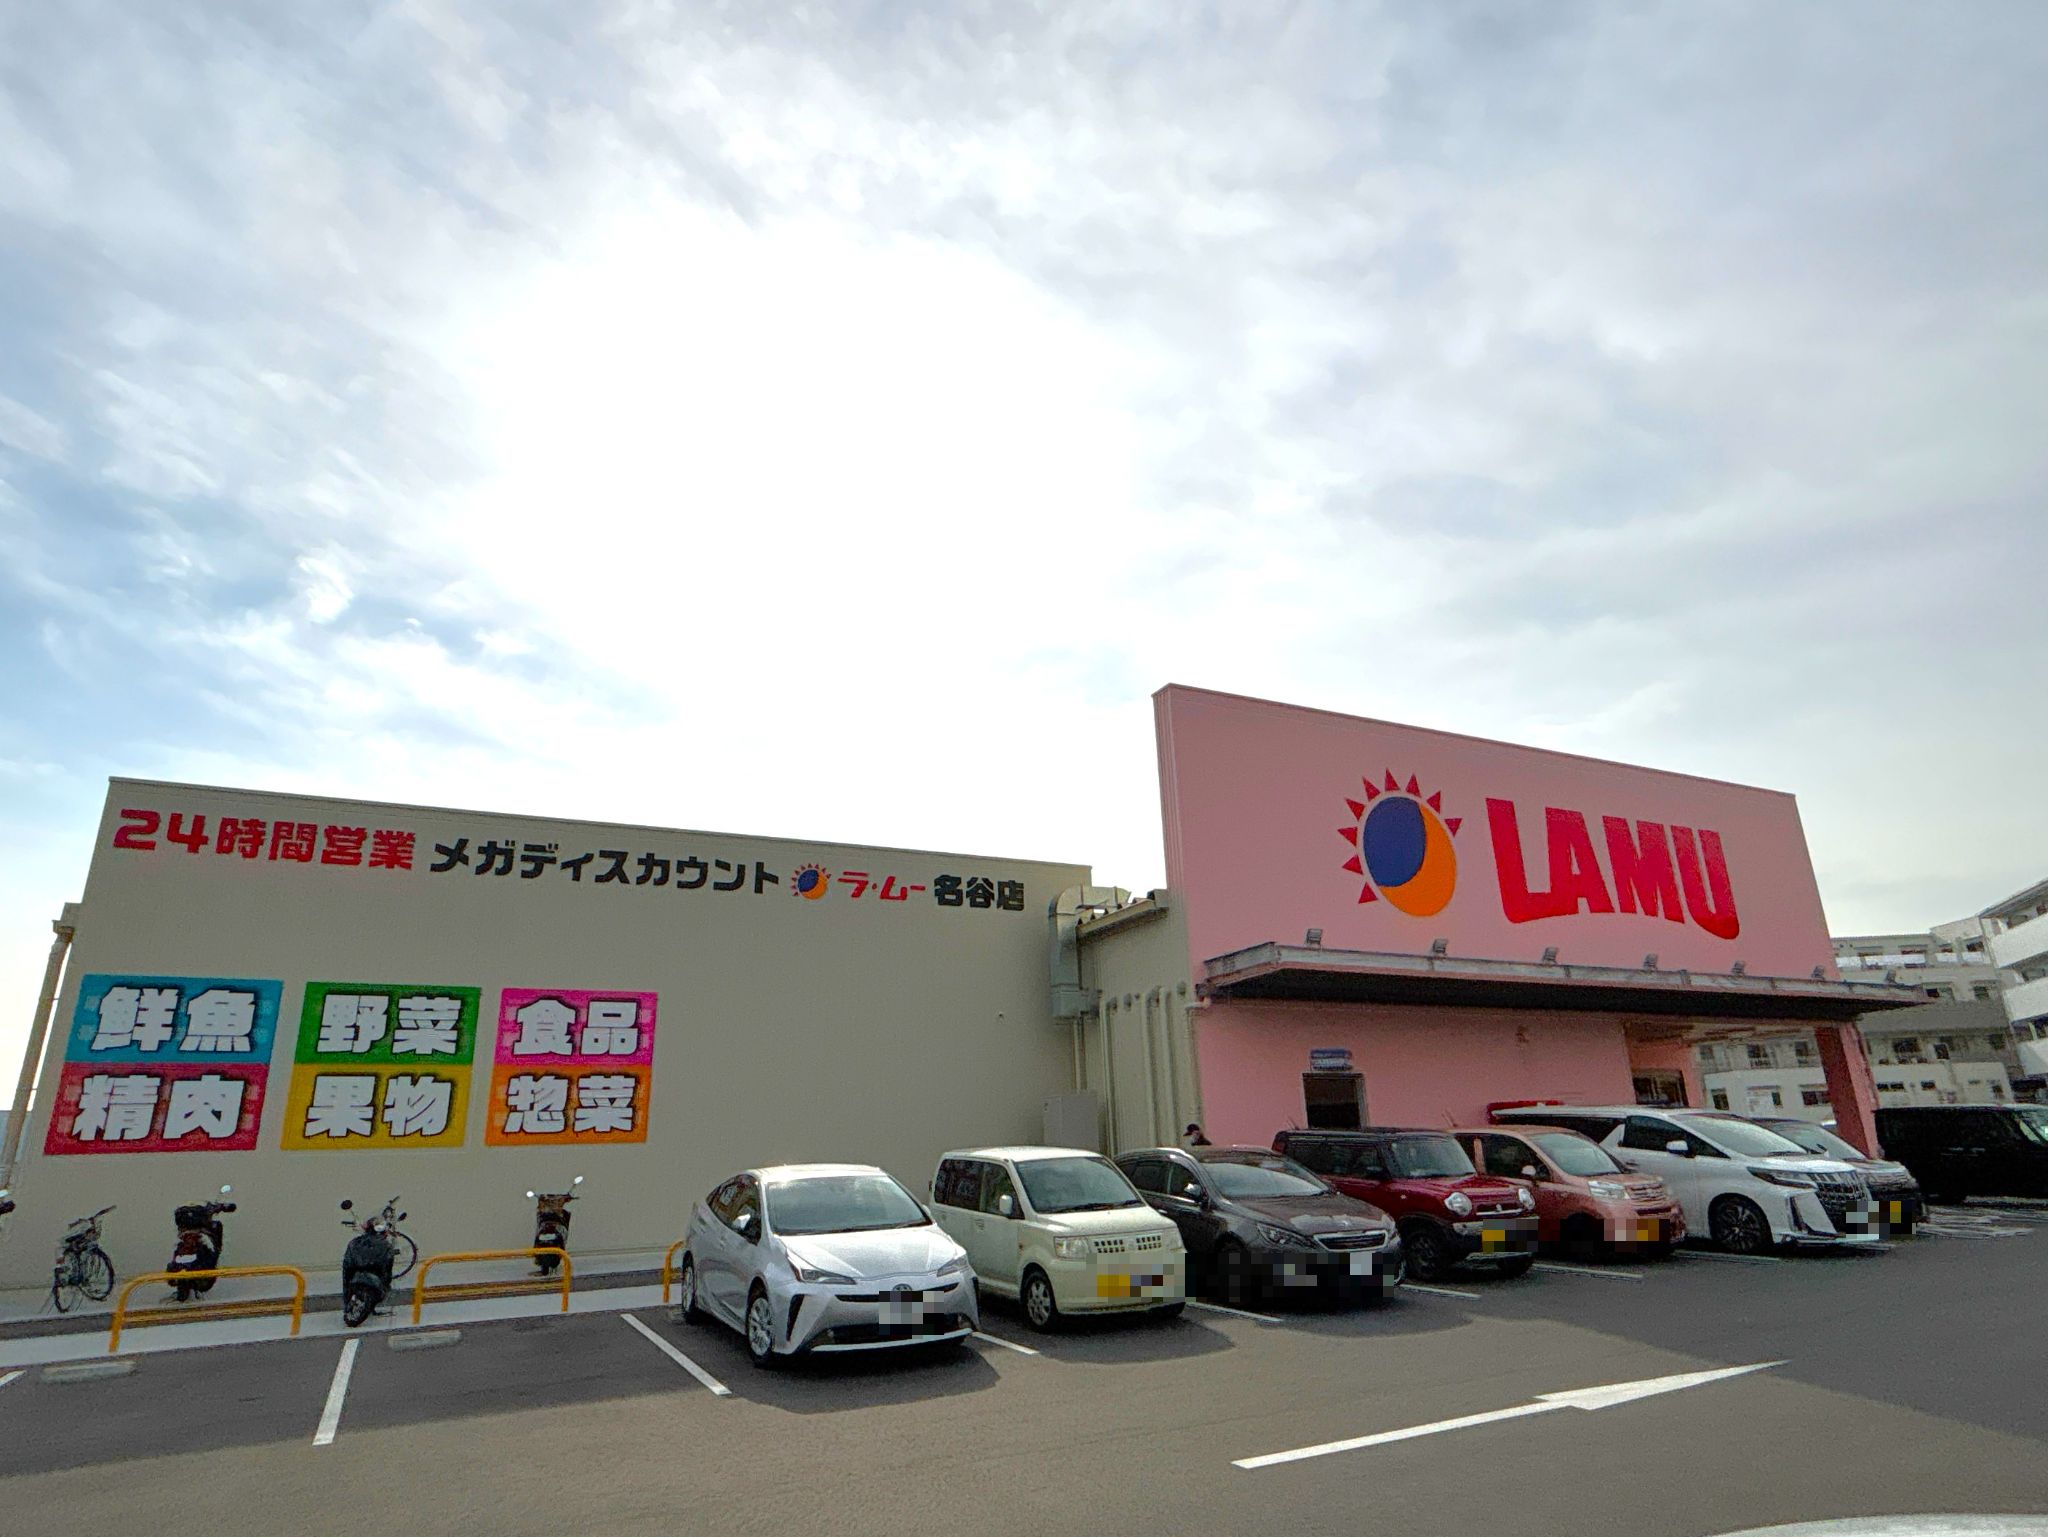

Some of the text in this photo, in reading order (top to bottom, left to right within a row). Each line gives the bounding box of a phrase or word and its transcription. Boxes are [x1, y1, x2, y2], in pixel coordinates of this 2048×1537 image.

[113, 809, 1025, 912] 24時間営業 メガディスカウント ラ・ムー 名谷店
[1485, 797, 1740, 941] LAMU
[91, 986, 256, 1052] 鮮魚
[317, 993, 463, 1055] 野菜
[513, 998, 639, 1056] 食品
[71, 1074, 246, 1141] 精肉
[305, 1074, 454, 1138] 果物
[503, 1074, 637, 1134] 惣菜
